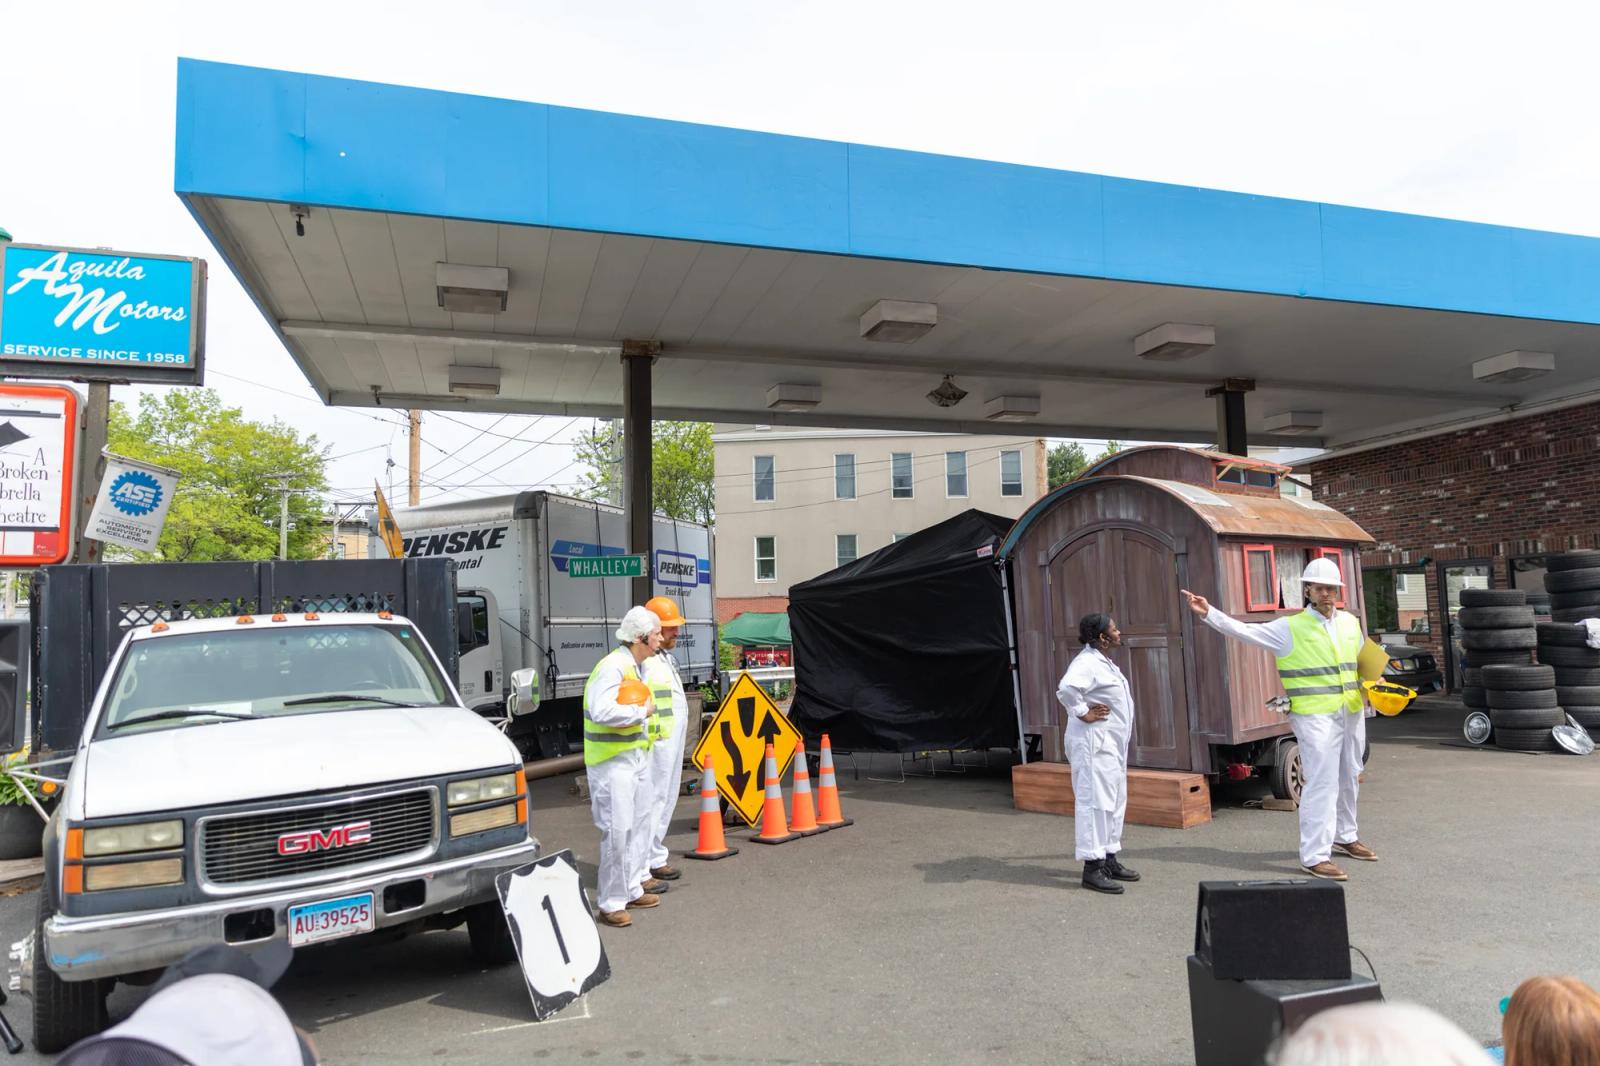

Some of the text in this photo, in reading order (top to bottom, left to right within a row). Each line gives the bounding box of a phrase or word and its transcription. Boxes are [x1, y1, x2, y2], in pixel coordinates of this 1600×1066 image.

[54, 282, 187, 335] Motors
[4, 343, 186, 364] SERVICE SINCE 1958
[33, 447, 46, 466] A
[114, 481, 157, 504] ASE
[115, 495, 151, 509] CERTIFIED
[95, 527, 150, 545] EXCELLENCE
[98, 519, 153, 536] AUTOMOTIVE
[106, 525, 142, 538] SERVICE
[569, 544, 584, 554] Local
[572, 559, 629, 576] WHALLEY
[630, 559, 639, 568] AV
[660, 561, 695, 577] PENSKE
[278, 821, 371, 855] GMC
[541, 894, 571, 965] 1
